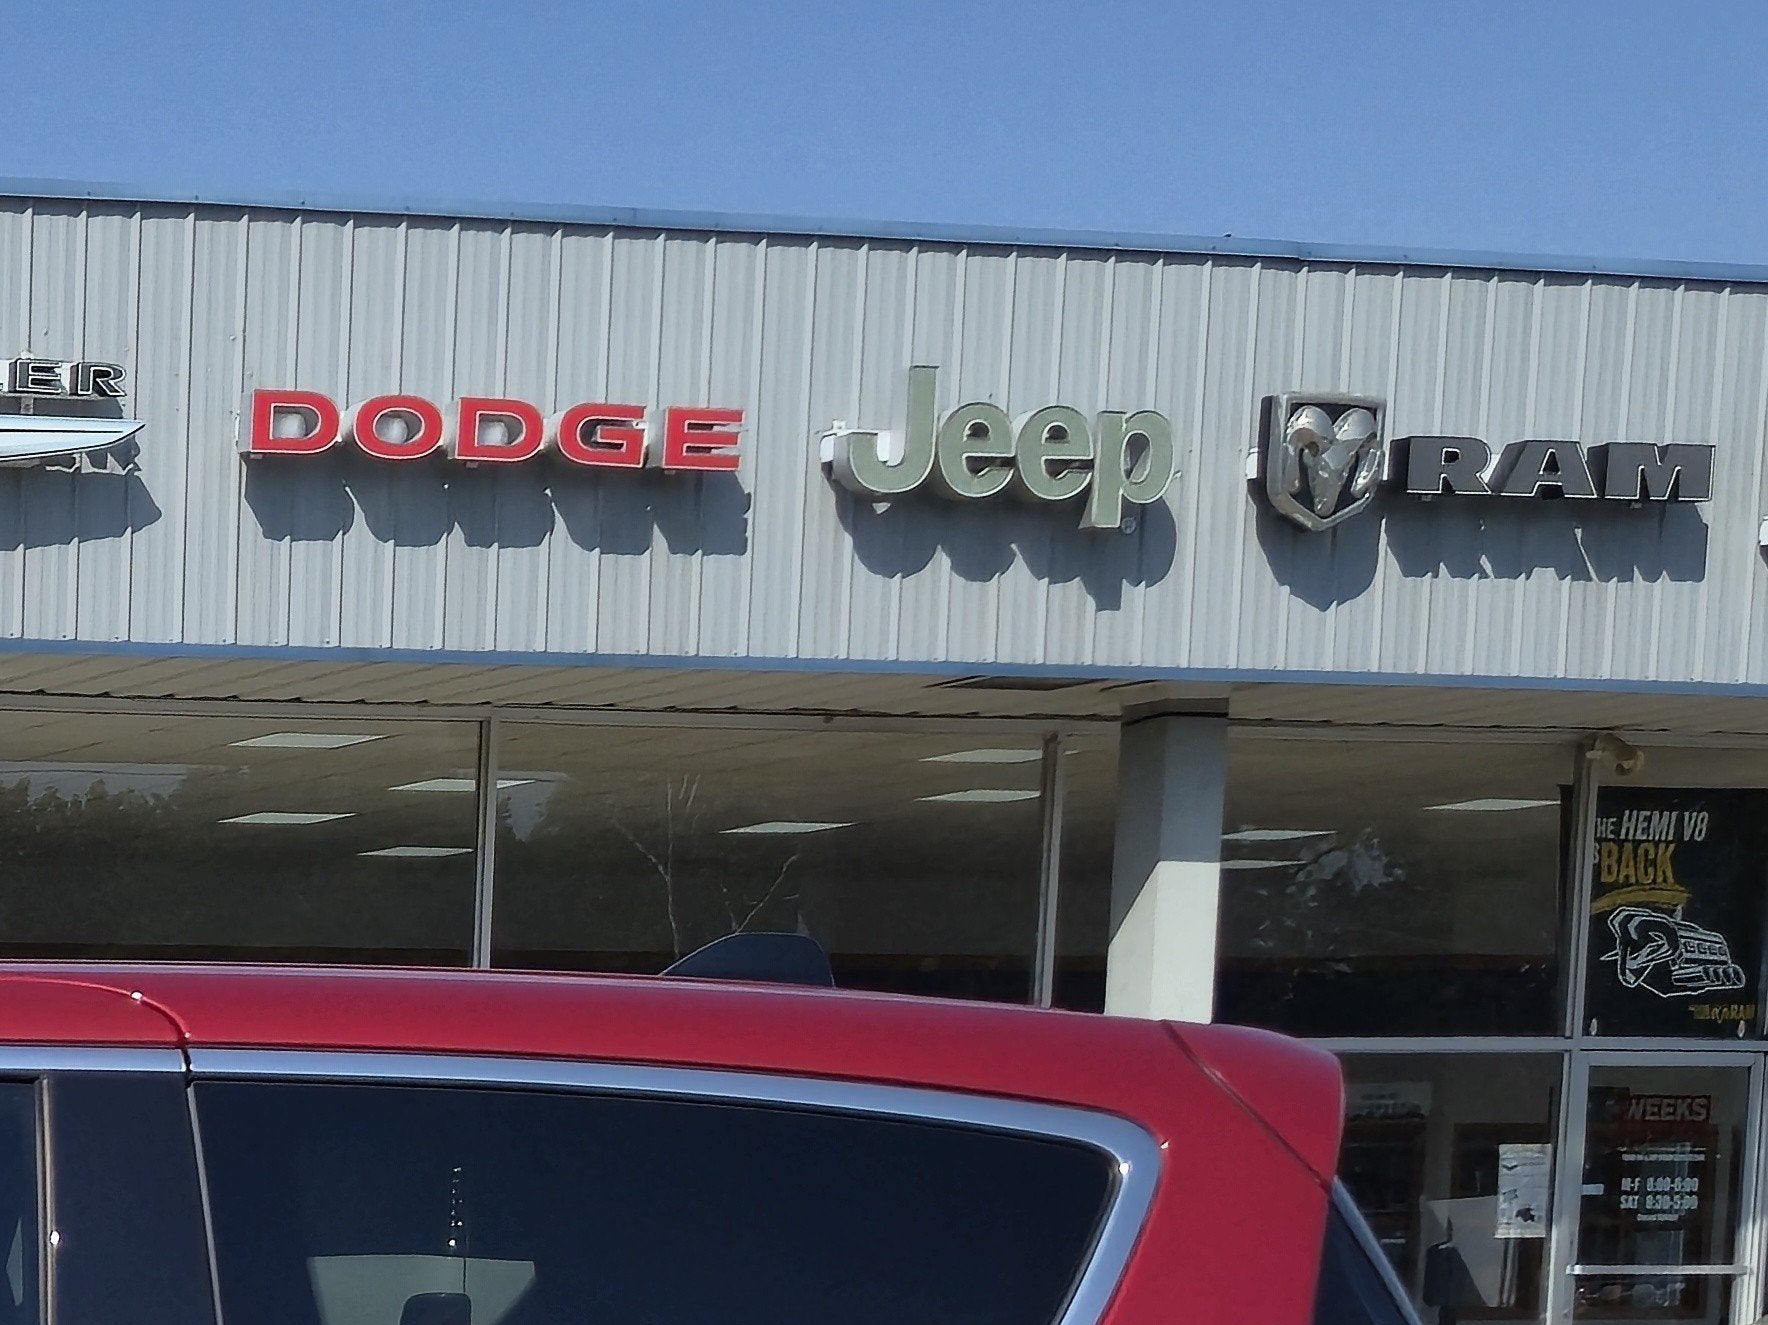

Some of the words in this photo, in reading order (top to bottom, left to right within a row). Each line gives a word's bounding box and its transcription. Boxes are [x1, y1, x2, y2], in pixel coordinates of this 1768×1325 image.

[248, 388, 745, 471] DODGE
[840, 364, 1175, 528] Jeep
[1400, 436, 1716, 502] RAM
[1596, 817, 1617, 839] HE
[1620, 809, 1679, 842] HEMI
[1683, 811, 1709, 842] V8
[1600, 841, 1677, 884] BACK
